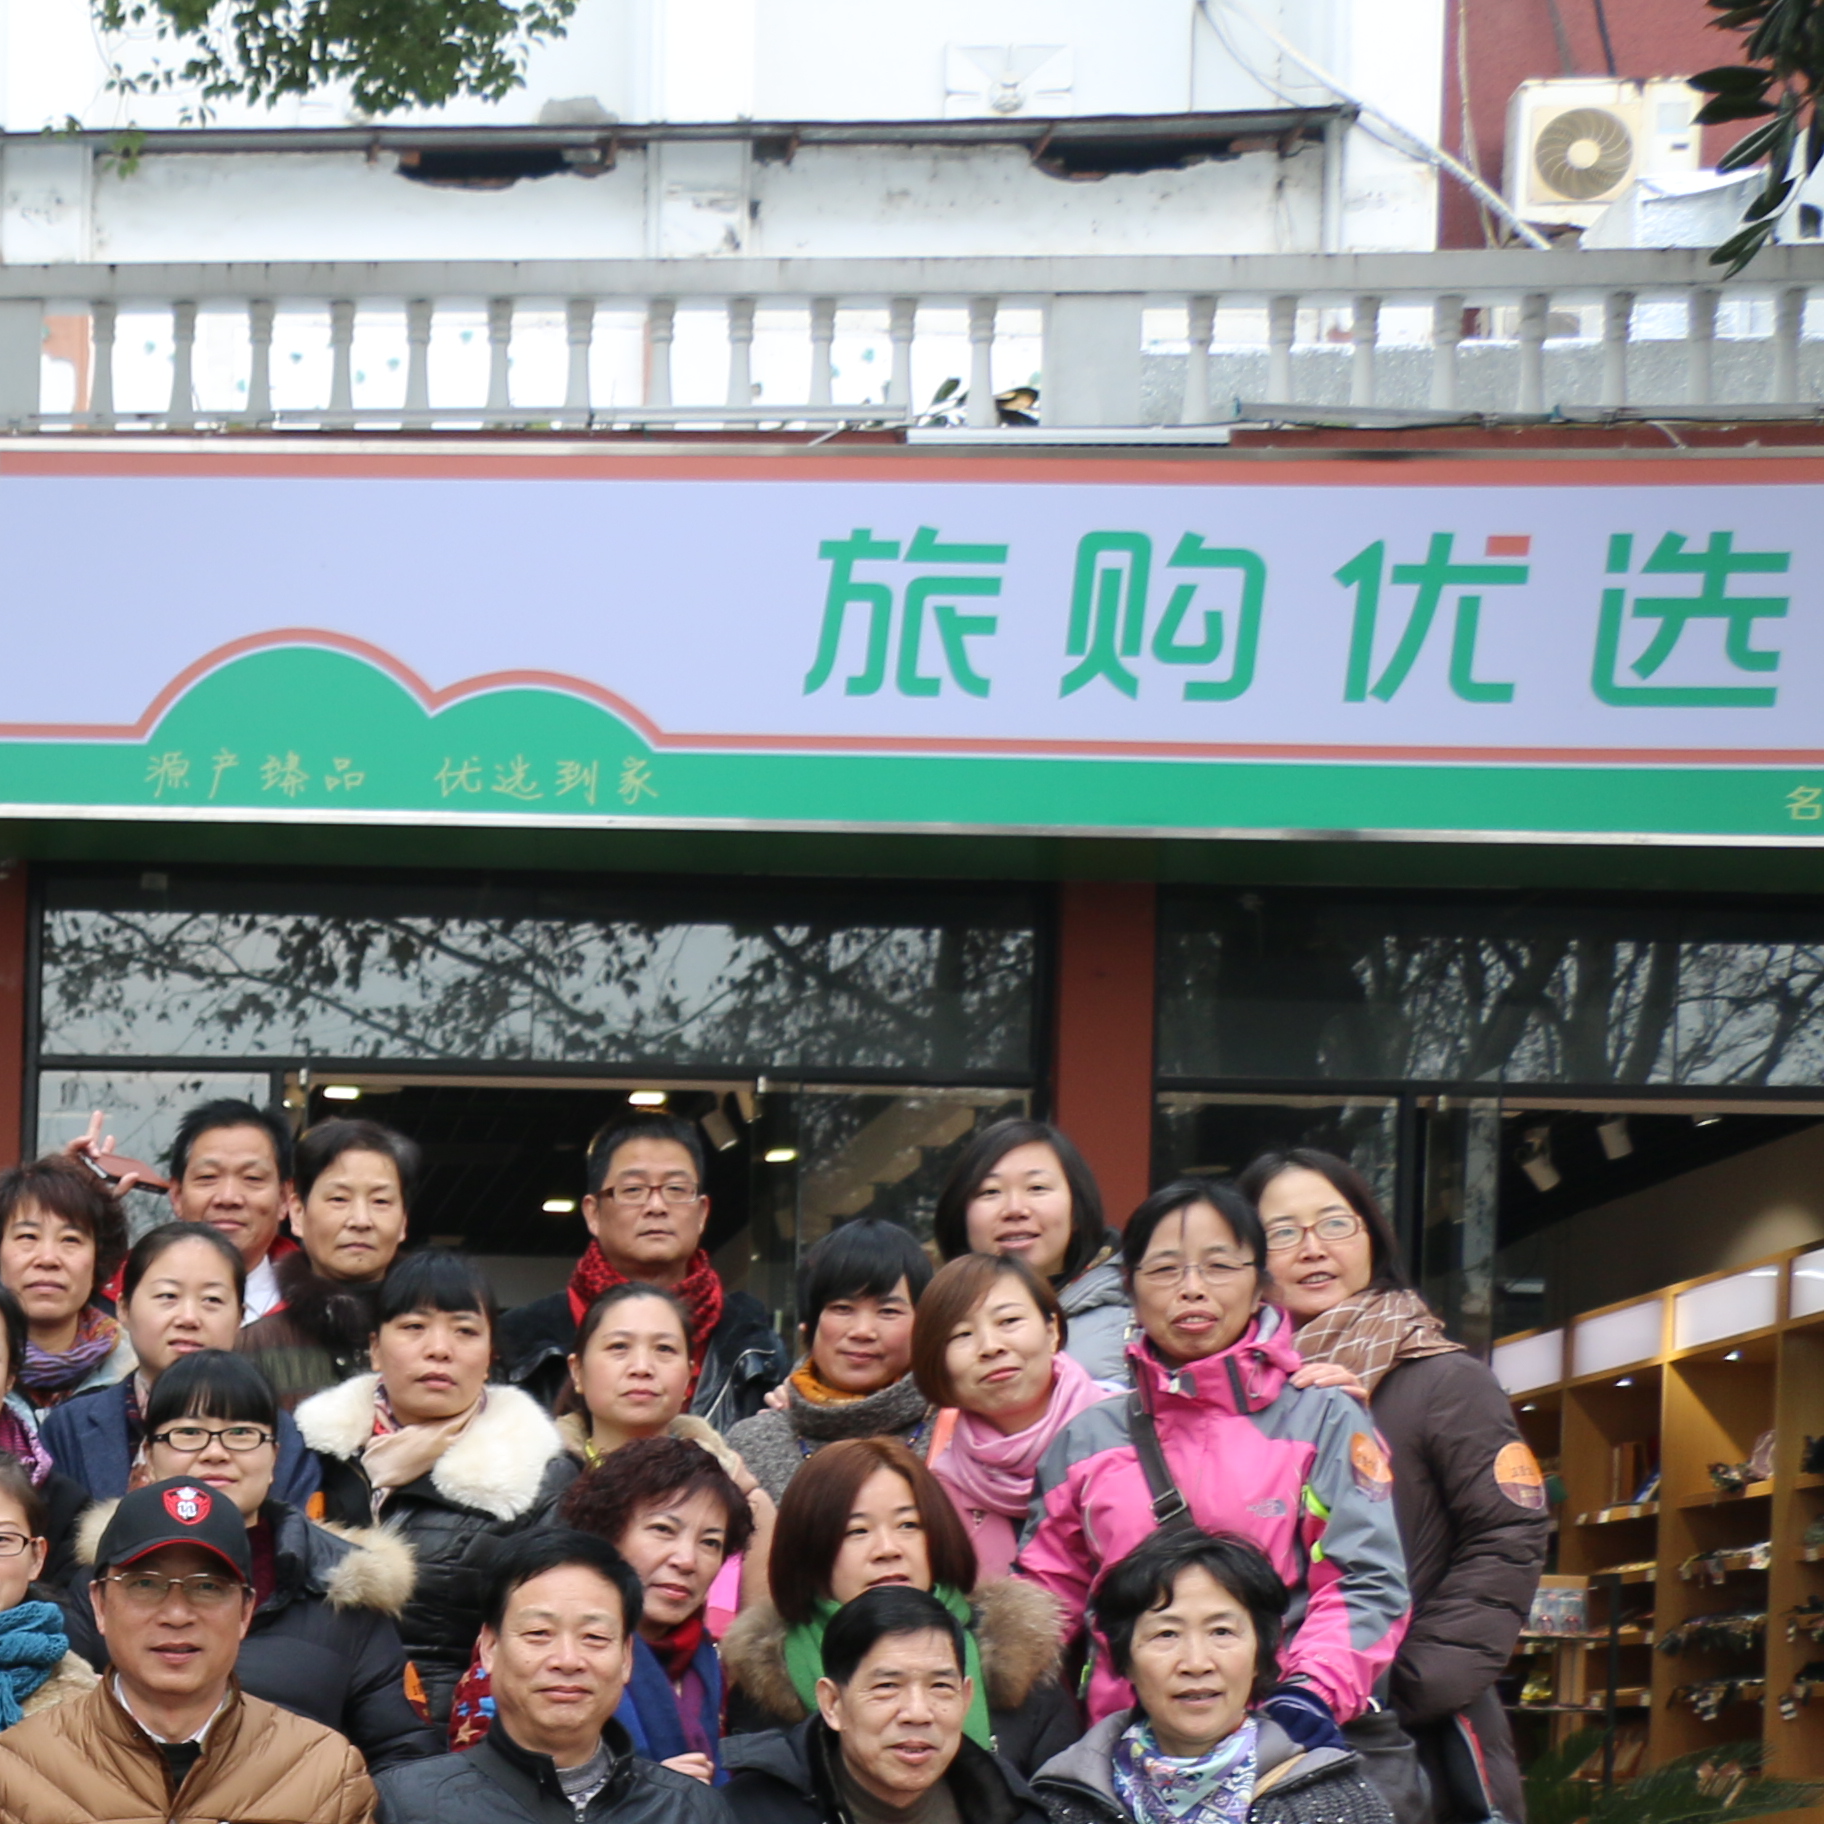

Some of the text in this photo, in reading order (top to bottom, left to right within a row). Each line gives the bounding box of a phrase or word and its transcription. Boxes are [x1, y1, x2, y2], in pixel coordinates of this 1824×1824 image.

[804, 525, 1790, 706] 旅购优选
[434, 755, 660, 806] 优选到家
[1784, 785, 1823, 821] 名
